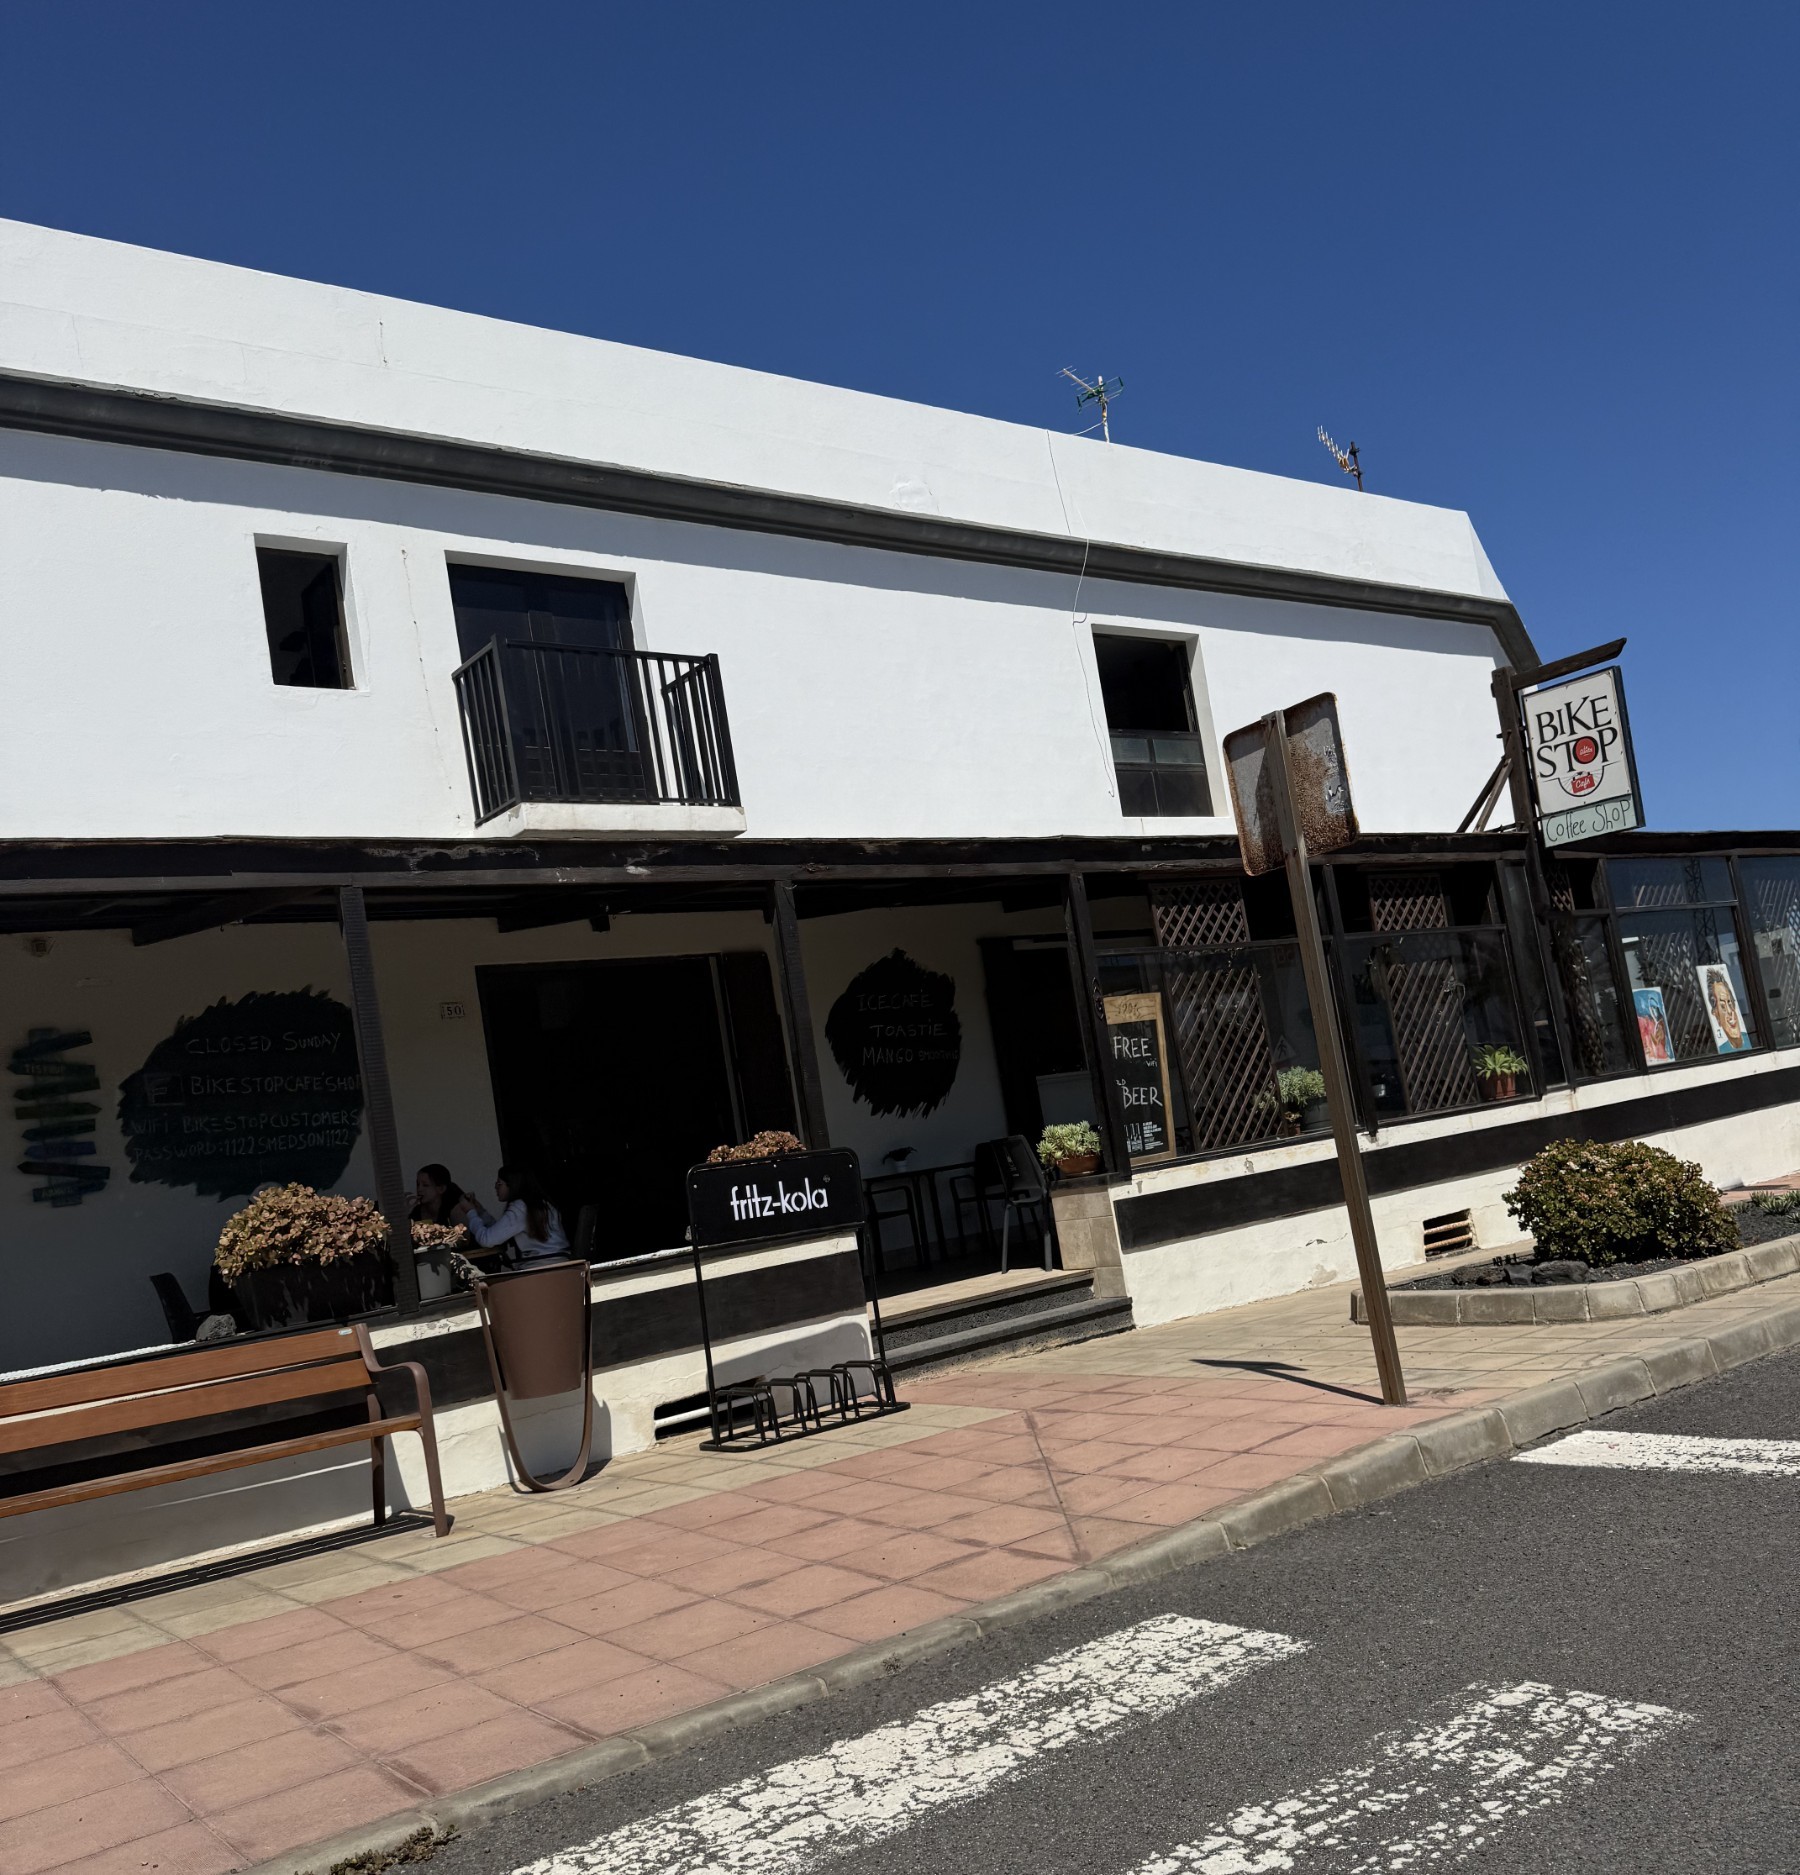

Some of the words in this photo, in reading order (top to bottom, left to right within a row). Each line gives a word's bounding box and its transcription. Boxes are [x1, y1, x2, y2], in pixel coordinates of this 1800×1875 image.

[1536, 695, 1612, 745] BIKE
[1536, 726, 1618, 778] STOP
[1546, 810, 1587, 842] Coffee
[185, 1036, 272, 1053] CLOSED
[862, 1046, 914, 1067] MANGO
[1113, 1035, 1152, 1060] FREE
[1121, 1086, 1163, 1109] BEER
[730, 1177, 829, 1221] fritz-kola
